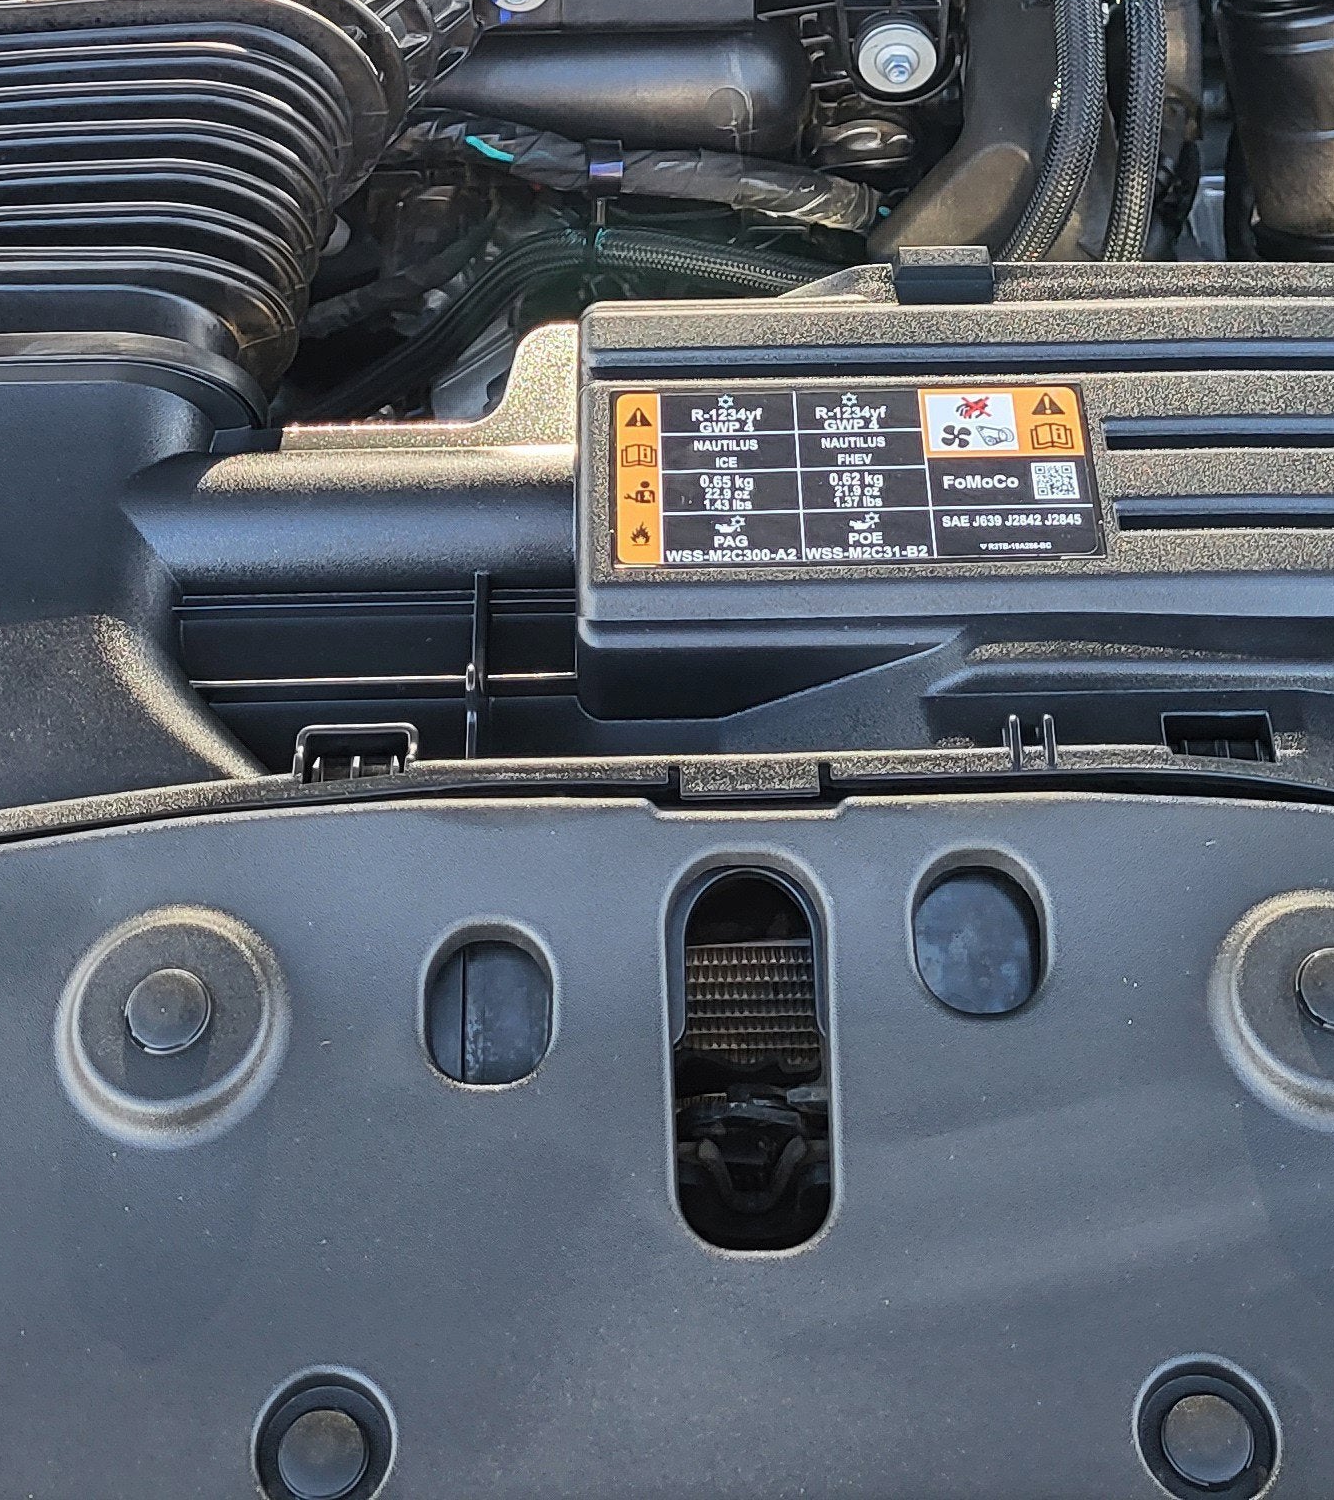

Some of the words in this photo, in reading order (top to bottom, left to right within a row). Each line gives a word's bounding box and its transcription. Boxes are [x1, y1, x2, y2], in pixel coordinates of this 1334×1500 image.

[691, 408, 763, 422] R-1234yf
[815, 405, 887, 420] R-1234yf
[699, 421, 740, 433] GWP
[744, 421, 755, 432] 4
[823, 419, 865, 431] GWP
[868, 420, 880, 430] 4
[693, 439, 759, 451] NAUTILUS
[820, 436, 886, 449] NAUTILUS
[715, 457, 738, 468] ICE
[837, 453, 873, 465] FHEV
[699, 474, 731, 488] 0.65
[734, 474, 754, 490] kg
[829, 471, 861, 486] 0.62
[864, 471, 884, 487] kg
[942, 474, 1020, 489] FoMoCo
[704, 488, 731, 499] 22.9
[734, 490, 750, 499] oz
[835, 485, 861, 497] 21.9
[864, 487, 880, 496] oz
[703, 499, 729, 510] 1.43
[732, 499, 752, 510] lbs
[833, 496, 860, 507] 1.37
[863, 496, 883, 507] lbs
[942, 515, 970, 527] SAE
[973, 514, 1002, 527] J639
[1005, 514, 1042, 527] J2842
[1045, 513, 1082, 526] J2845
[713, 535, 748, 548] PAG
[848, 531, 884, 545] POE
[667, 547, 798, 562] WSS-M2C300-A2
[806, 545, 929, 560] WSS-M2C31-B2
